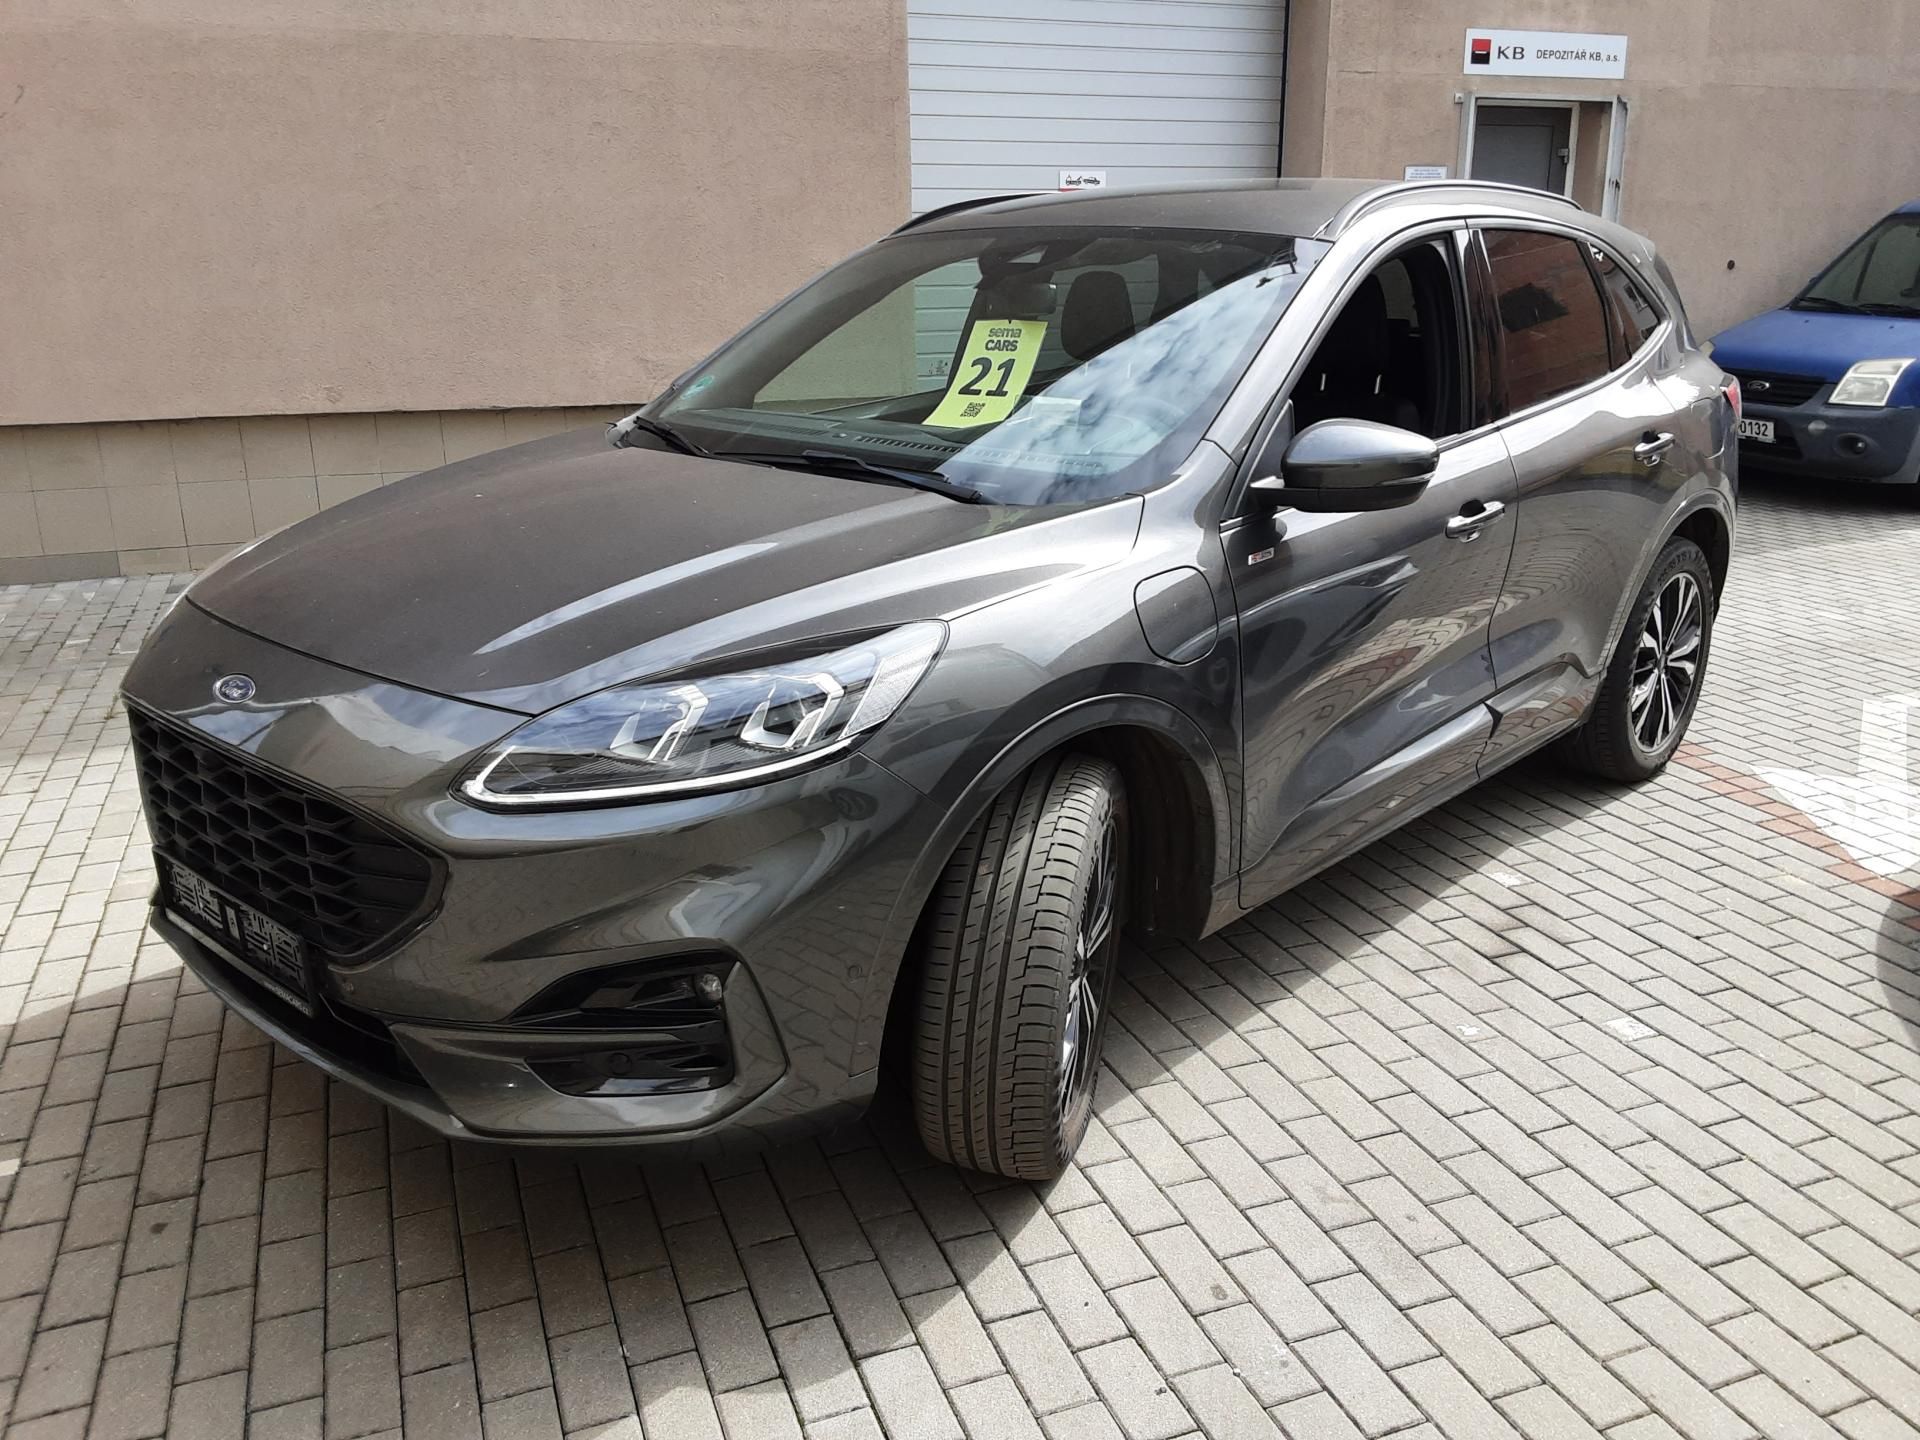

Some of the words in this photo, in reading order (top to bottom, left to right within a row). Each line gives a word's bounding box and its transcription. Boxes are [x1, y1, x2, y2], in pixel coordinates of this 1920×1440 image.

[1497, 46, 1525, 60] KB
[1536, 48, 1587, 61] DEPOZITÁŘ
[1589, 51, 1604, 63] KB,
[1606, 54, 1620, 62] a.s.
[988, 328, 1022, 338] sema
[985, 340, 1018, 352] CARS
[958, 357, 1016, 396] 21
[1740, 421, 1768, 437] 0132
